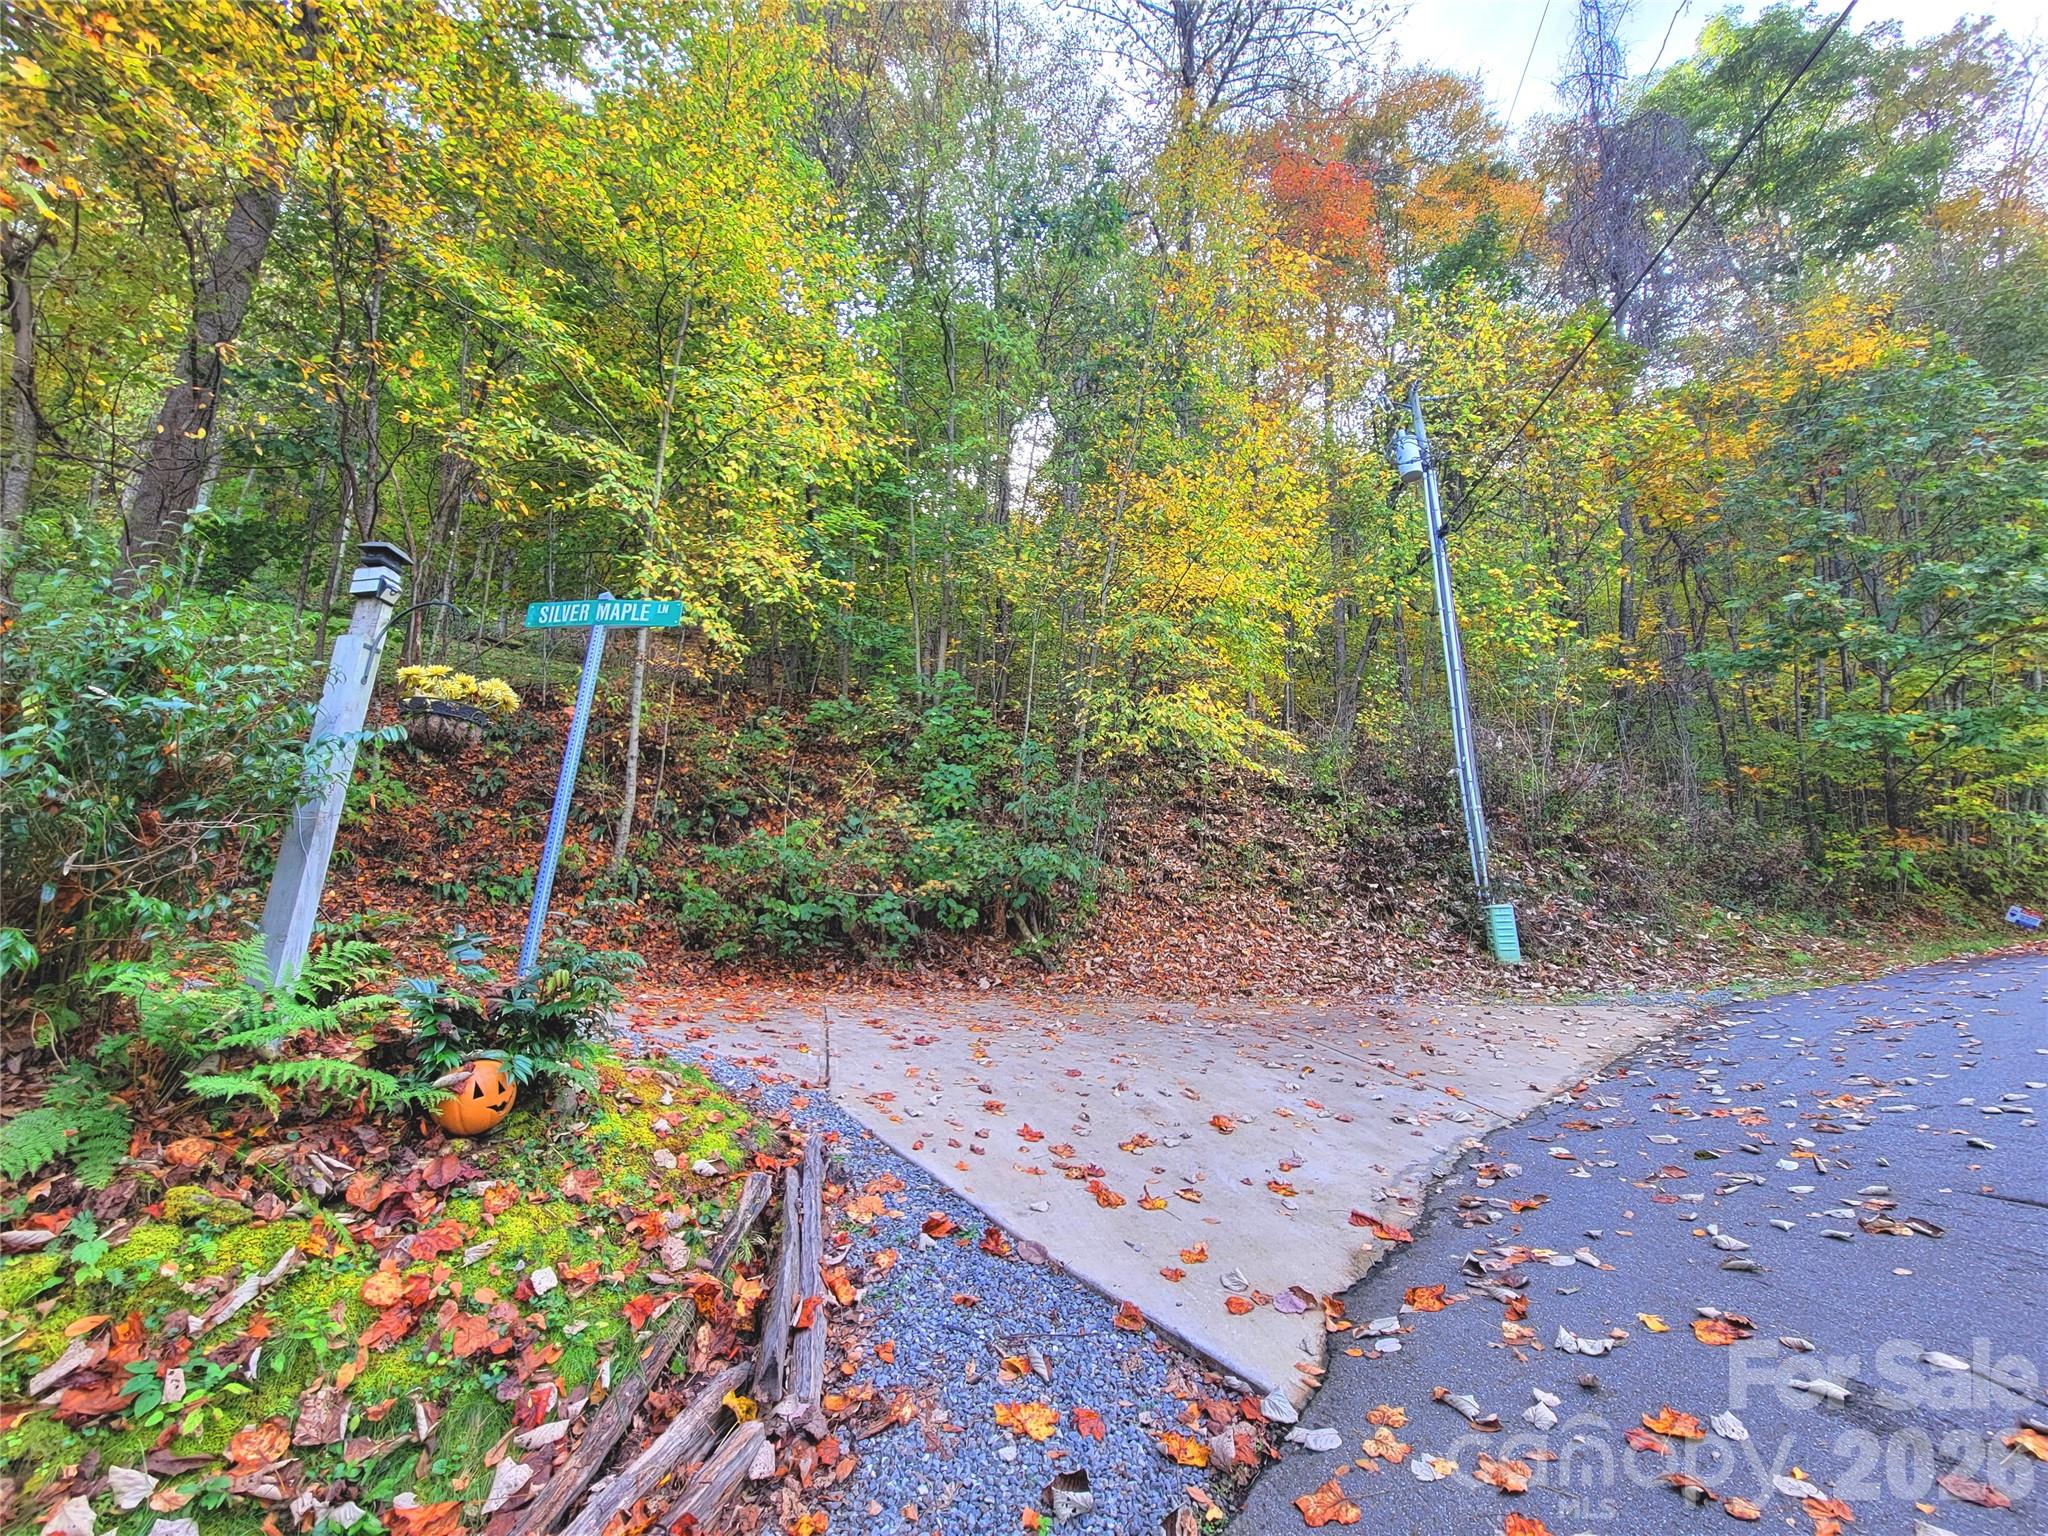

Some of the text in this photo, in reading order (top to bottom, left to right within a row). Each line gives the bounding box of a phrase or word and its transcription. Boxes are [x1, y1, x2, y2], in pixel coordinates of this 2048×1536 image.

[538, 603, 670, 624] SILVER MAPLE LN
